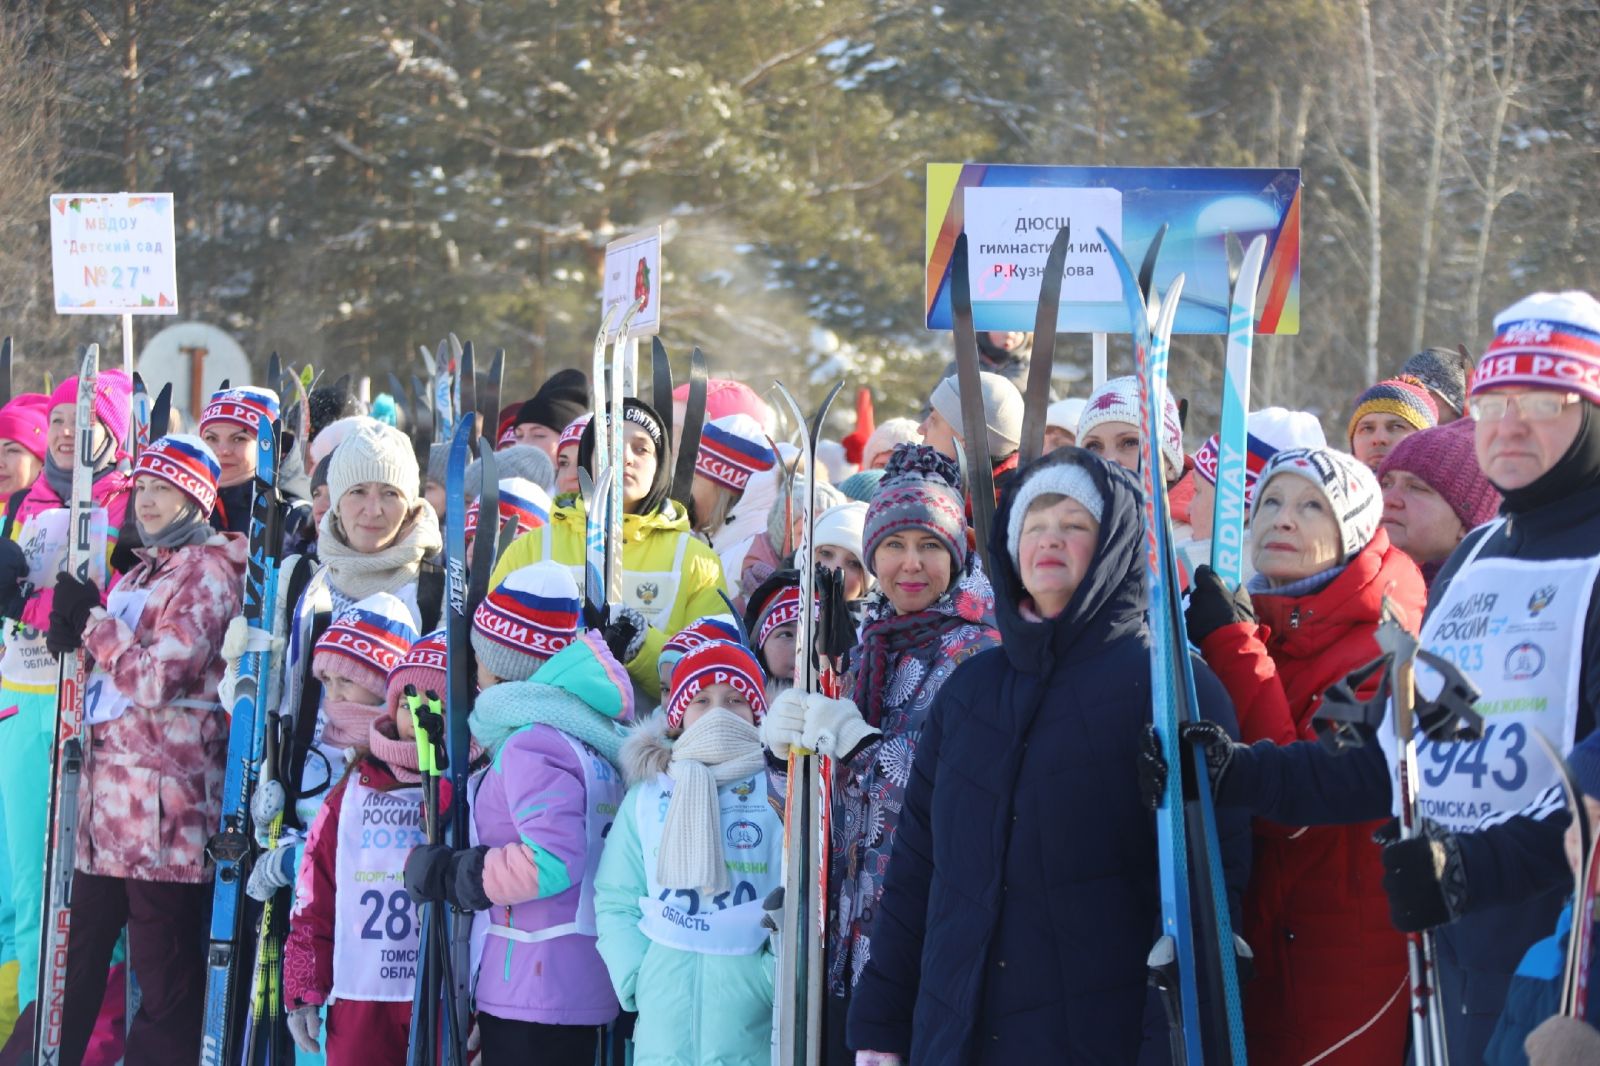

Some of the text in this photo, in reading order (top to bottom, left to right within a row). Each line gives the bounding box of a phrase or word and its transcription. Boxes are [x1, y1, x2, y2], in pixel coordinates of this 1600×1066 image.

[1015, 216, 1071, 233] ДЮСШ
[136, 241, 163, 253] сад
[979, 242, 1107, 255] гимнастии им.
[993, 264, 1095, 281] Р.Кузнова
[1532, 355, 1600, 387] РОС
[234, 406, 260, 424] РО
[626, 408, 662, 445] CONTROL
[696, 452, 748, 488] ОССИИ
[449, 559, 465, 616] ATEMI
[475, 603, 528, 643] ОССИИ
[1421, 800, 1492, 819] ТОМСКАЯ
[360, 889, 421, 942] 28
[661, 906, 711, 932] ОБЛАСТЬ
[48, 909, 72, 1047] CONTOUR
[380, 966, 416, 979] ОБЛА
